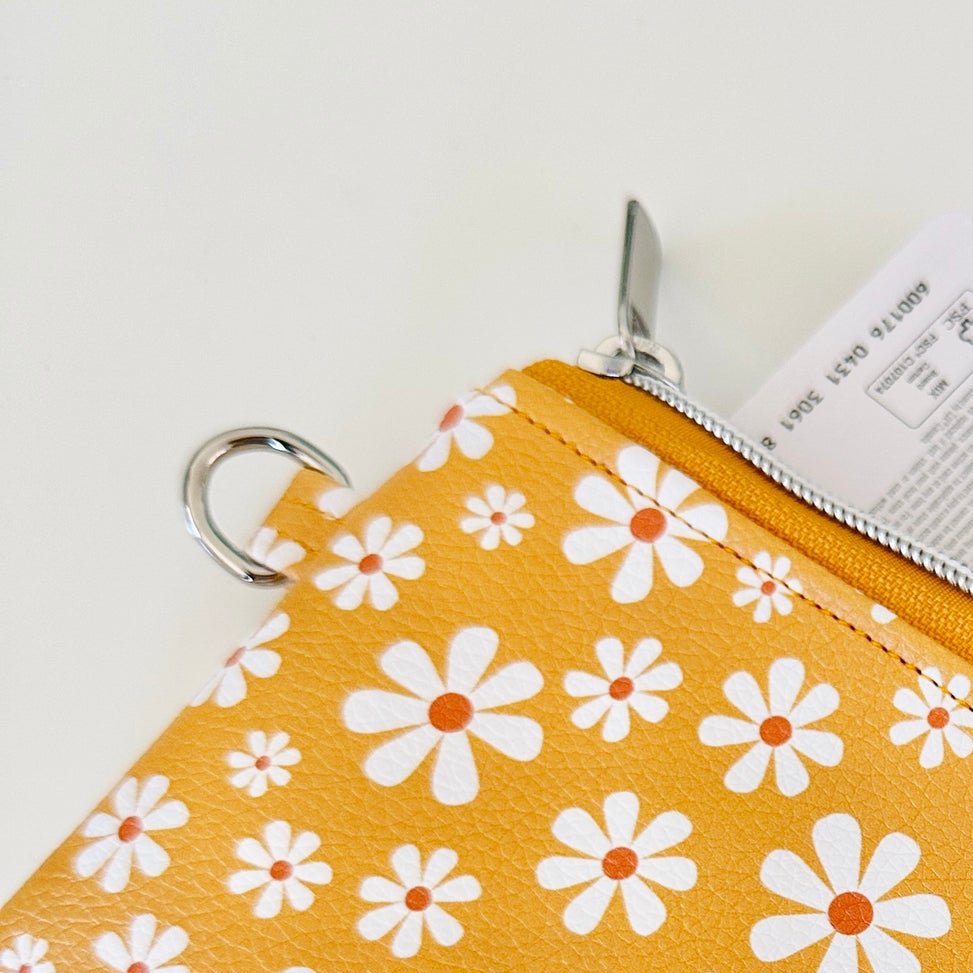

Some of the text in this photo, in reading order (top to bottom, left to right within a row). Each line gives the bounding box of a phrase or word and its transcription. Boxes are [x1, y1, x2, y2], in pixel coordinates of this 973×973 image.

[942, 301, 972, 329] FSC
[760, 281, 930, 451] 600176 0431 3061 8
